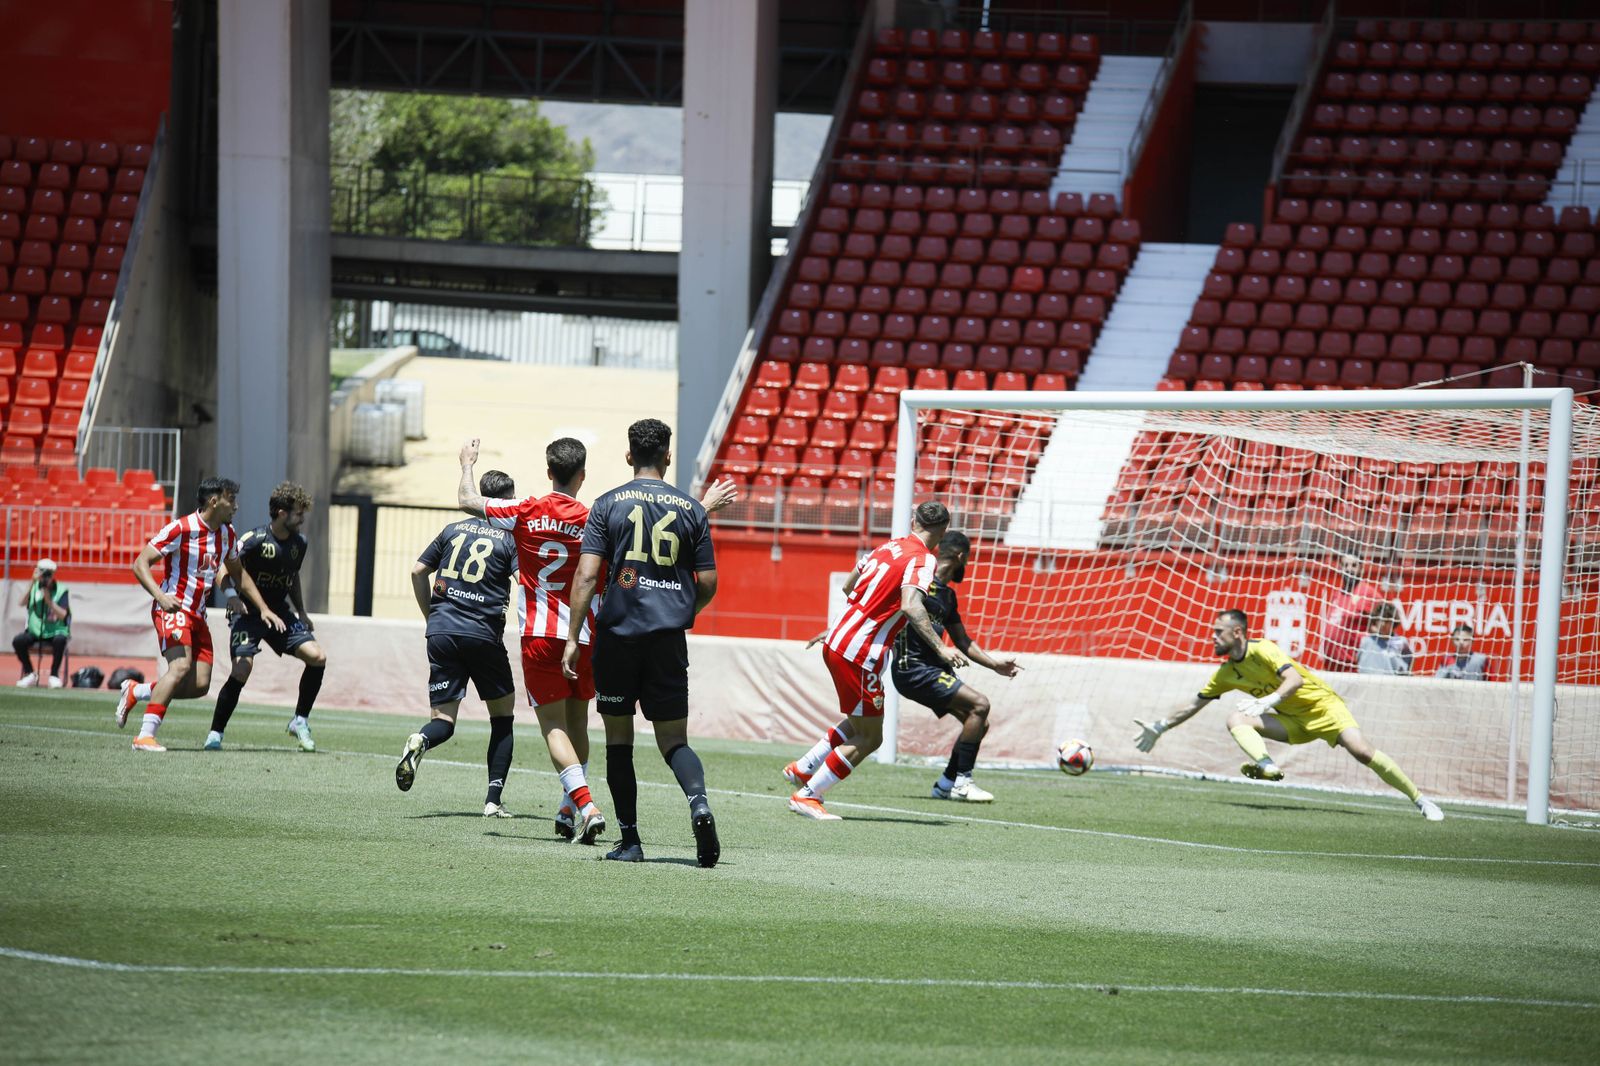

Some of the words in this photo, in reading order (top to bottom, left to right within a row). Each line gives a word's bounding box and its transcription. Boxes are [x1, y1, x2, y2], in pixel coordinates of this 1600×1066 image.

[614, 490, 654, 503] JUANMA
[657, 494, 692, 510] PORRO
[625, 504, 680, 567] 16
[261, 542, 276, 559] 20
[440, 532, 494, 584] 18
[537, 541, 569, 591] 2
[639, 576, 682, 591] Candela
[848, 558, 891, 607] 21
[447, 587, 485, 603] Candela
[164, 611, 187, 630] 29
[231, 631, 249, 647] 20
